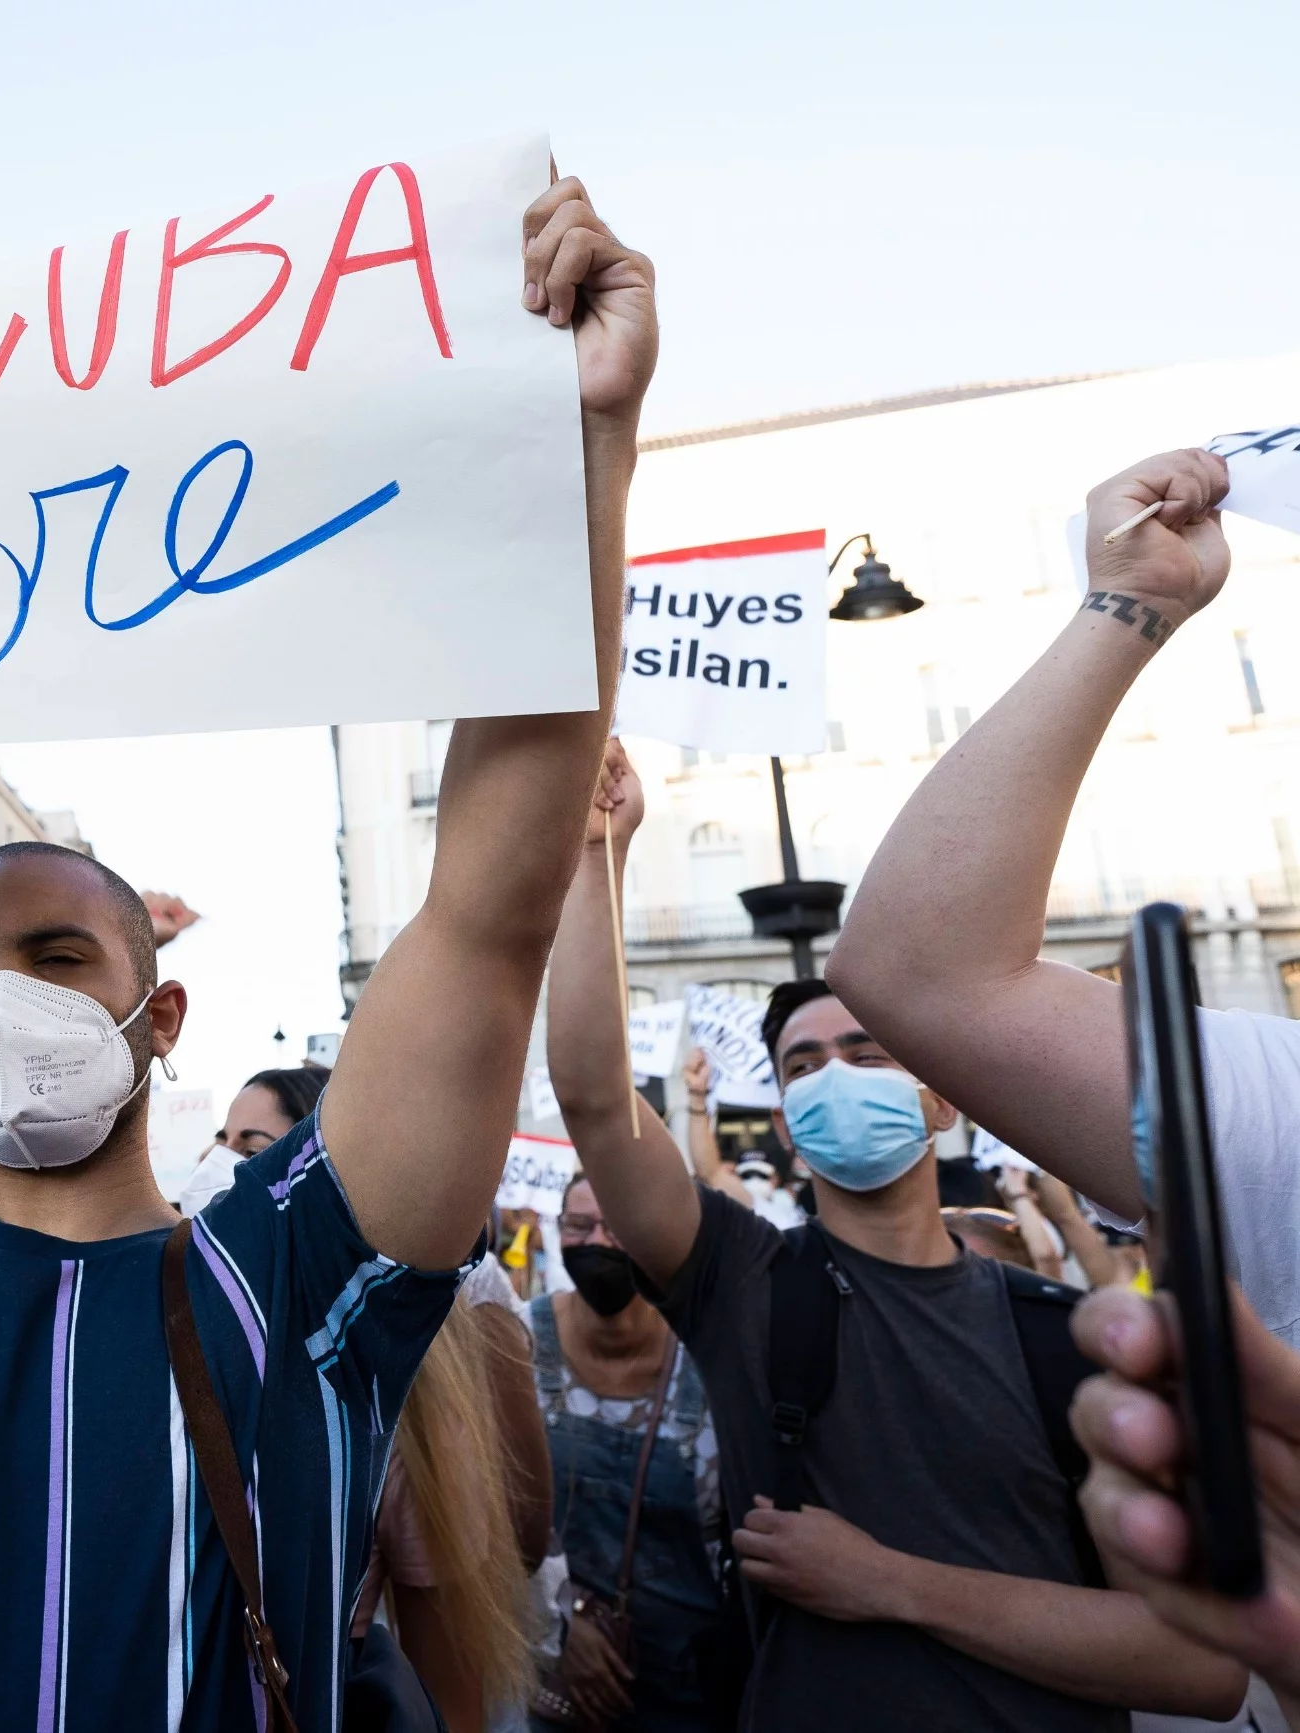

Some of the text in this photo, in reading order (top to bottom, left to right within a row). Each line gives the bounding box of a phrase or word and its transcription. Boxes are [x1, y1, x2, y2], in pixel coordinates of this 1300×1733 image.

[626, 583, 803, 629] Huyes
[621, 638, 788, 690] silan.
[23, 1054, 52, 1065] YPHD
[26, 1073, 46, 1083] FFP2
[50, 1071, 62, 1080] NR
